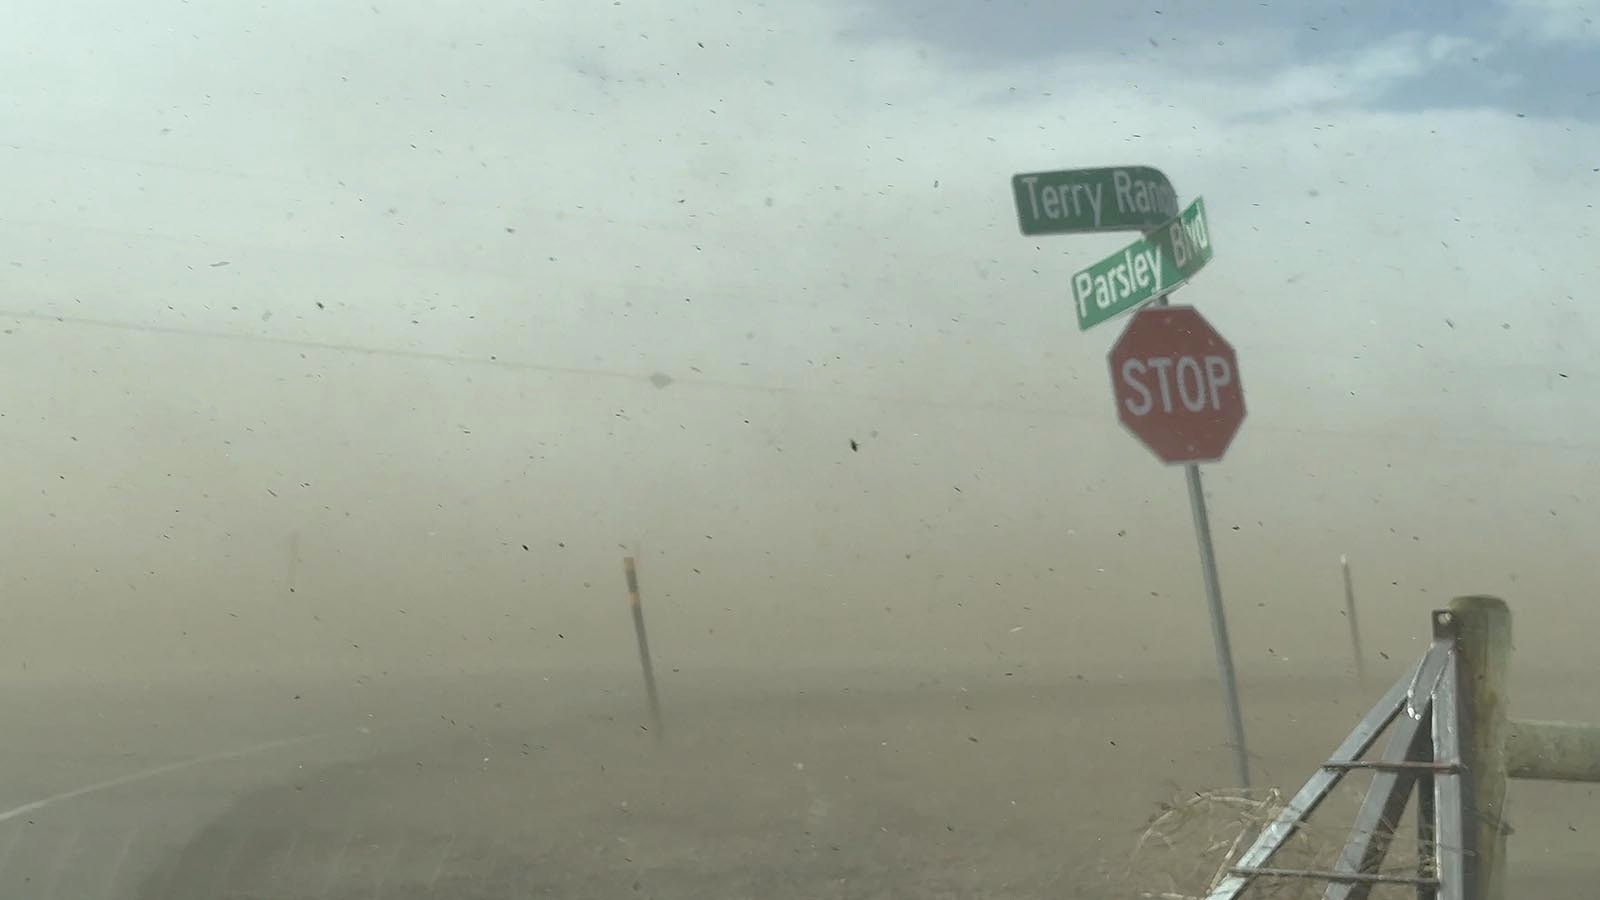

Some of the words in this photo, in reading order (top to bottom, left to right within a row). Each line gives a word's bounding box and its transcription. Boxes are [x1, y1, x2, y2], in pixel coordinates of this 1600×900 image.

[1022, 177, 1102, 227] Terry
[1075, 245, 1163, 318] Parsley
[1169, 202, 1208, 268] Blvd
[1122, 355, 1231, 416] STOP
